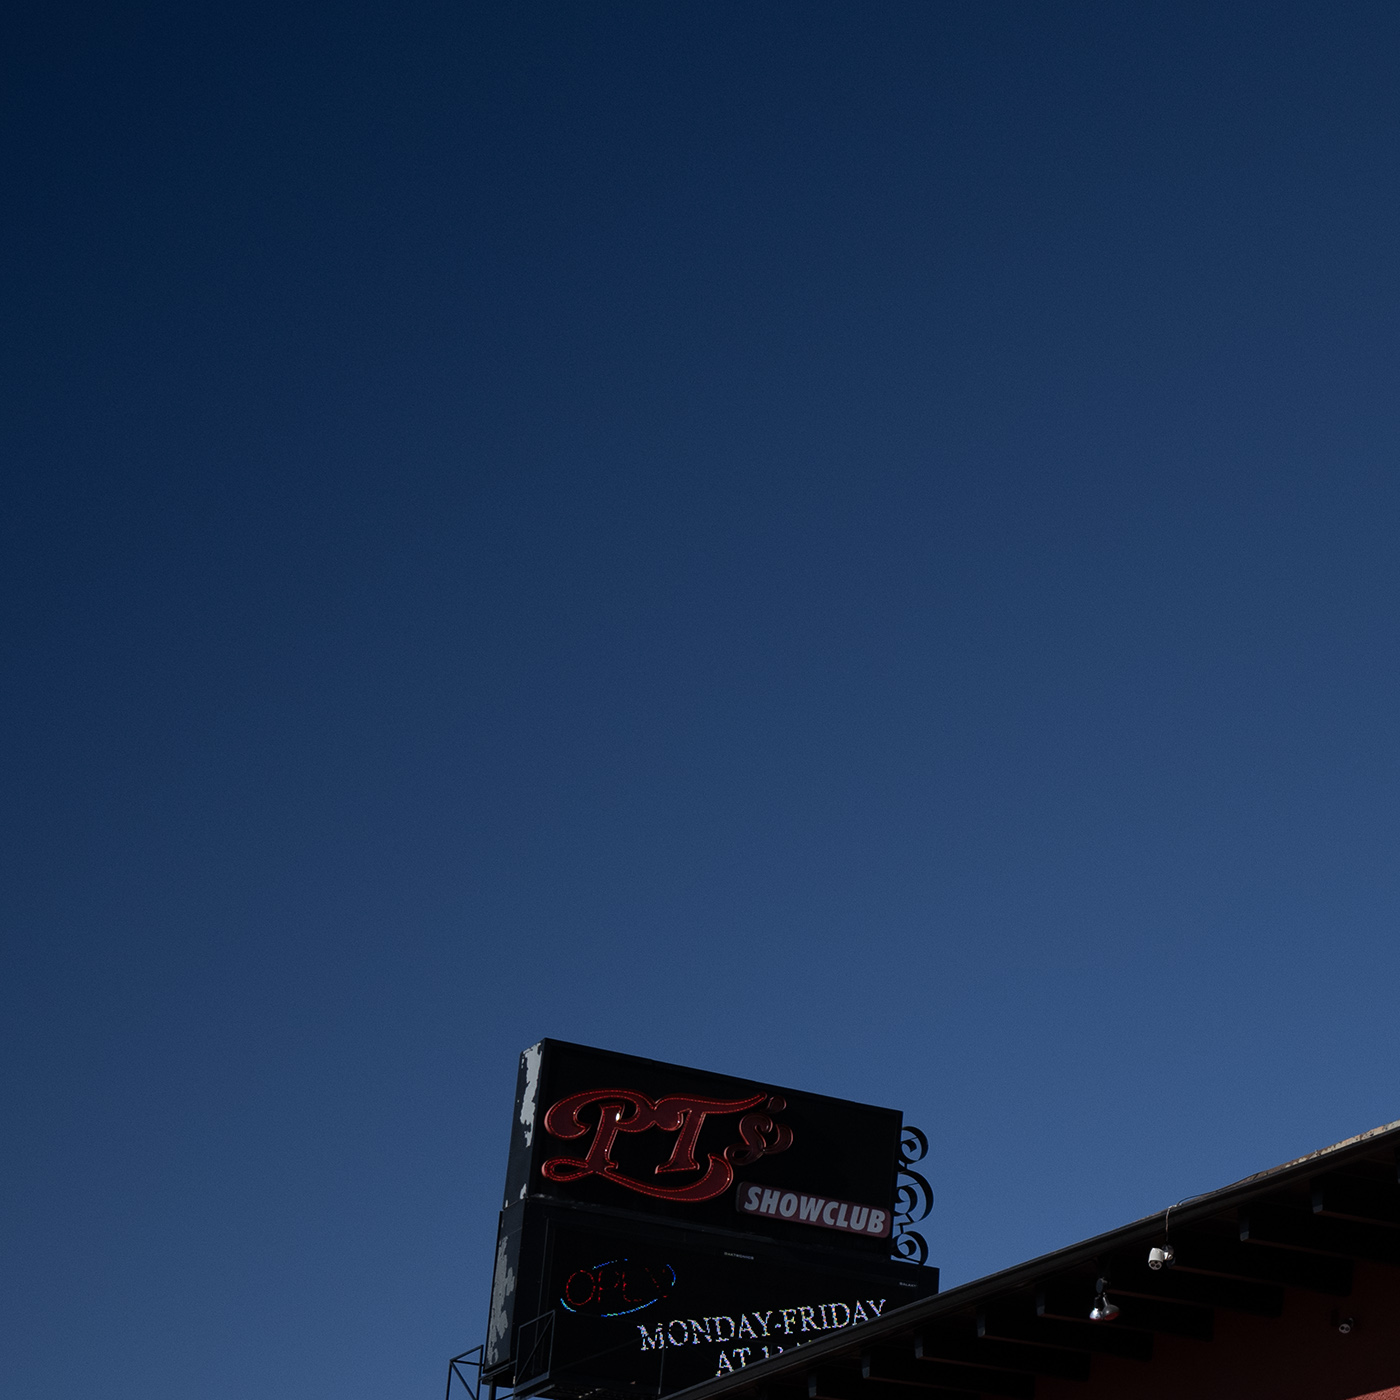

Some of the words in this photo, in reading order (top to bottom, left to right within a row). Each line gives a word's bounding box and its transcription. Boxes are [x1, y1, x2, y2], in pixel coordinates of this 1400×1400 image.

[744, 1186, 886, 1234] SHOWCLUB
[637, 1299, 887, 1350] MONDAY-FRIDAY
[716, 1347, 751, 1377] AT
